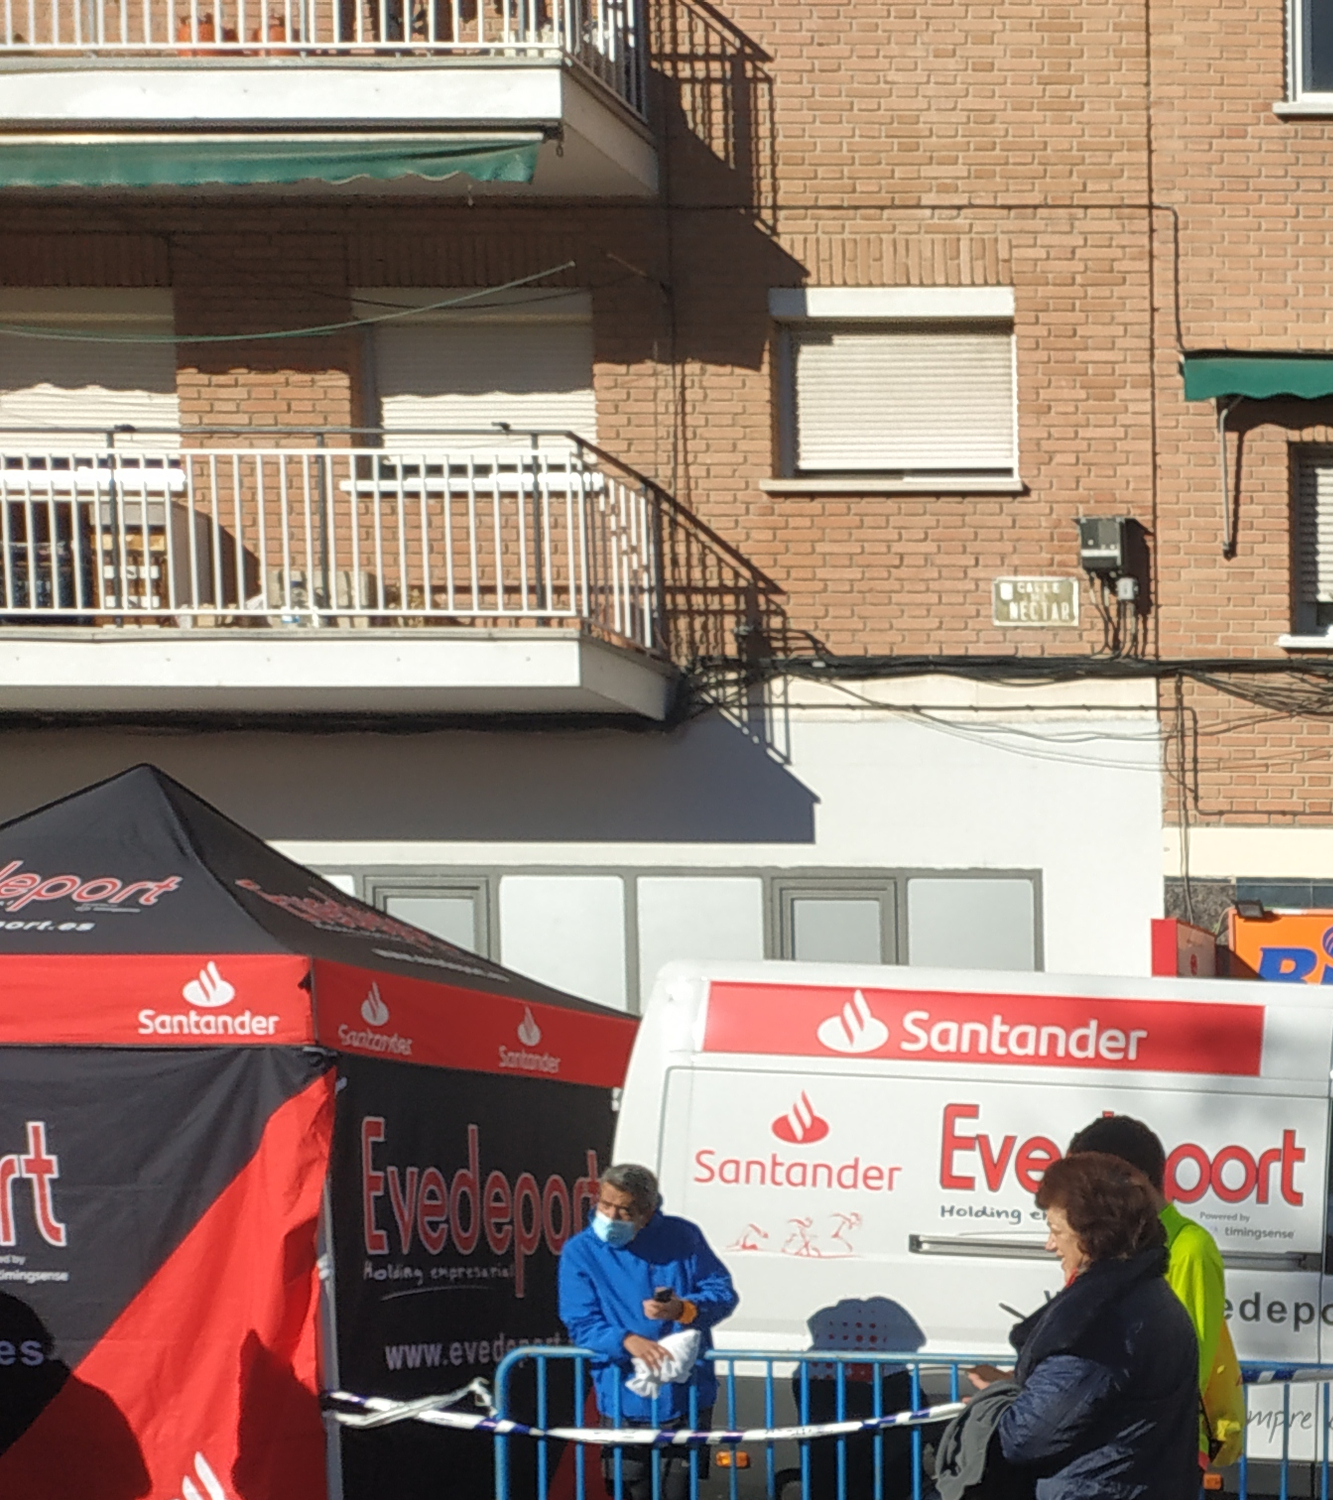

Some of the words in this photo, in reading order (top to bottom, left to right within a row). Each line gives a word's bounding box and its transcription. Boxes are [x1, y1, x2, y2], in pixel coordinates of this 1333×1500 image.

[138, 1009, 280, 1035] Santander
[900, 1010, 1147, 1061] Santander
[338, 1023, 414, 1057] Santander
[694, 1149, 903, 1191] Santander
[940, 1103, 1306, 1207] Eveport
[940, 1205, 1022, 1225] Holding
[1200, 1211, 1238, 1222] Powered
[1240, 1211, 1251, 1223] by
[1224, 1226, 1294, 1241] timingsense
